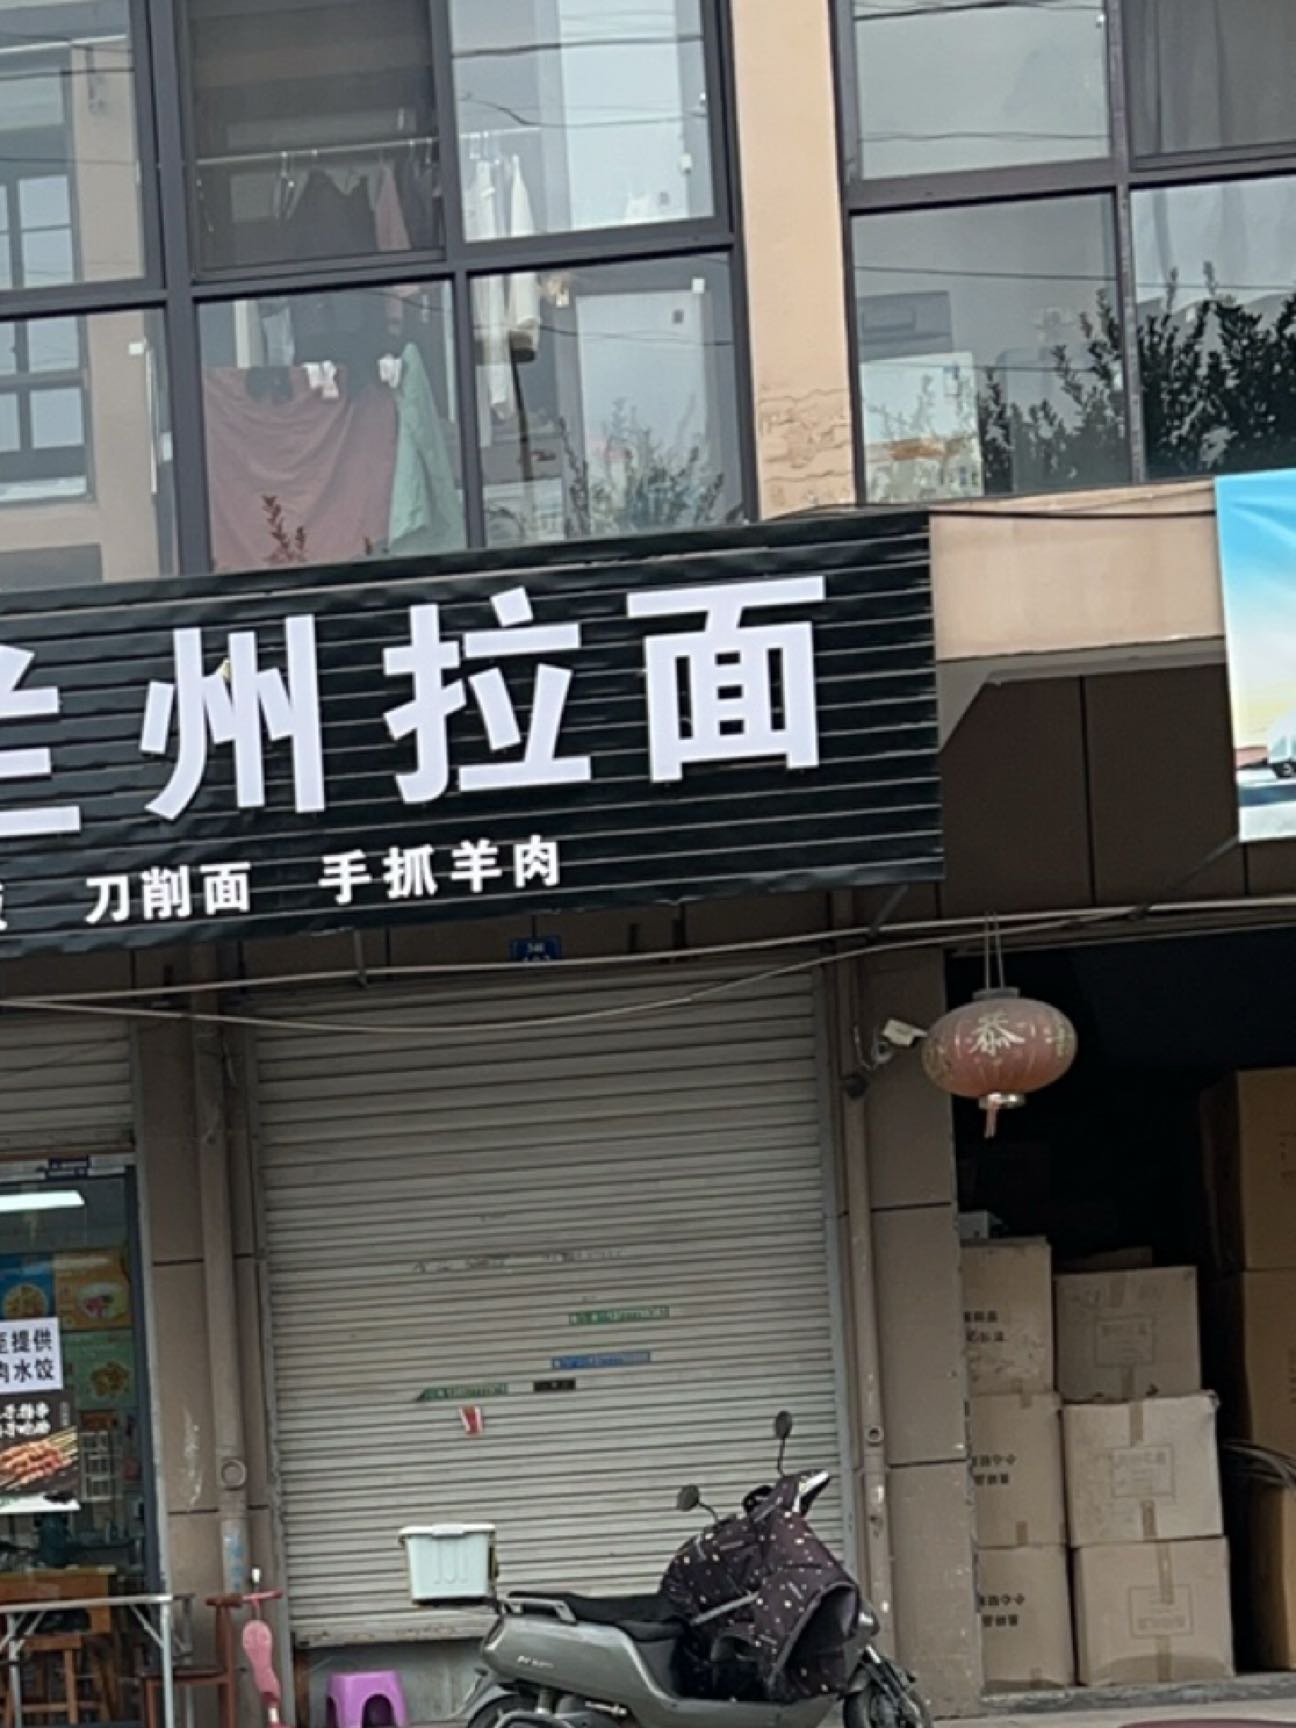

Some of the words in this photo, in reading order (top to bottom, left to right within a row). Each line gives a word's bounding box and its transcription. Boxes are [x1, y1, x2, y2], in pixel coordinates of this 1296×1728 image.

[85, 861, 251, 924] 刀削面
[318, 833, 560, 904] 手抓羊肉
